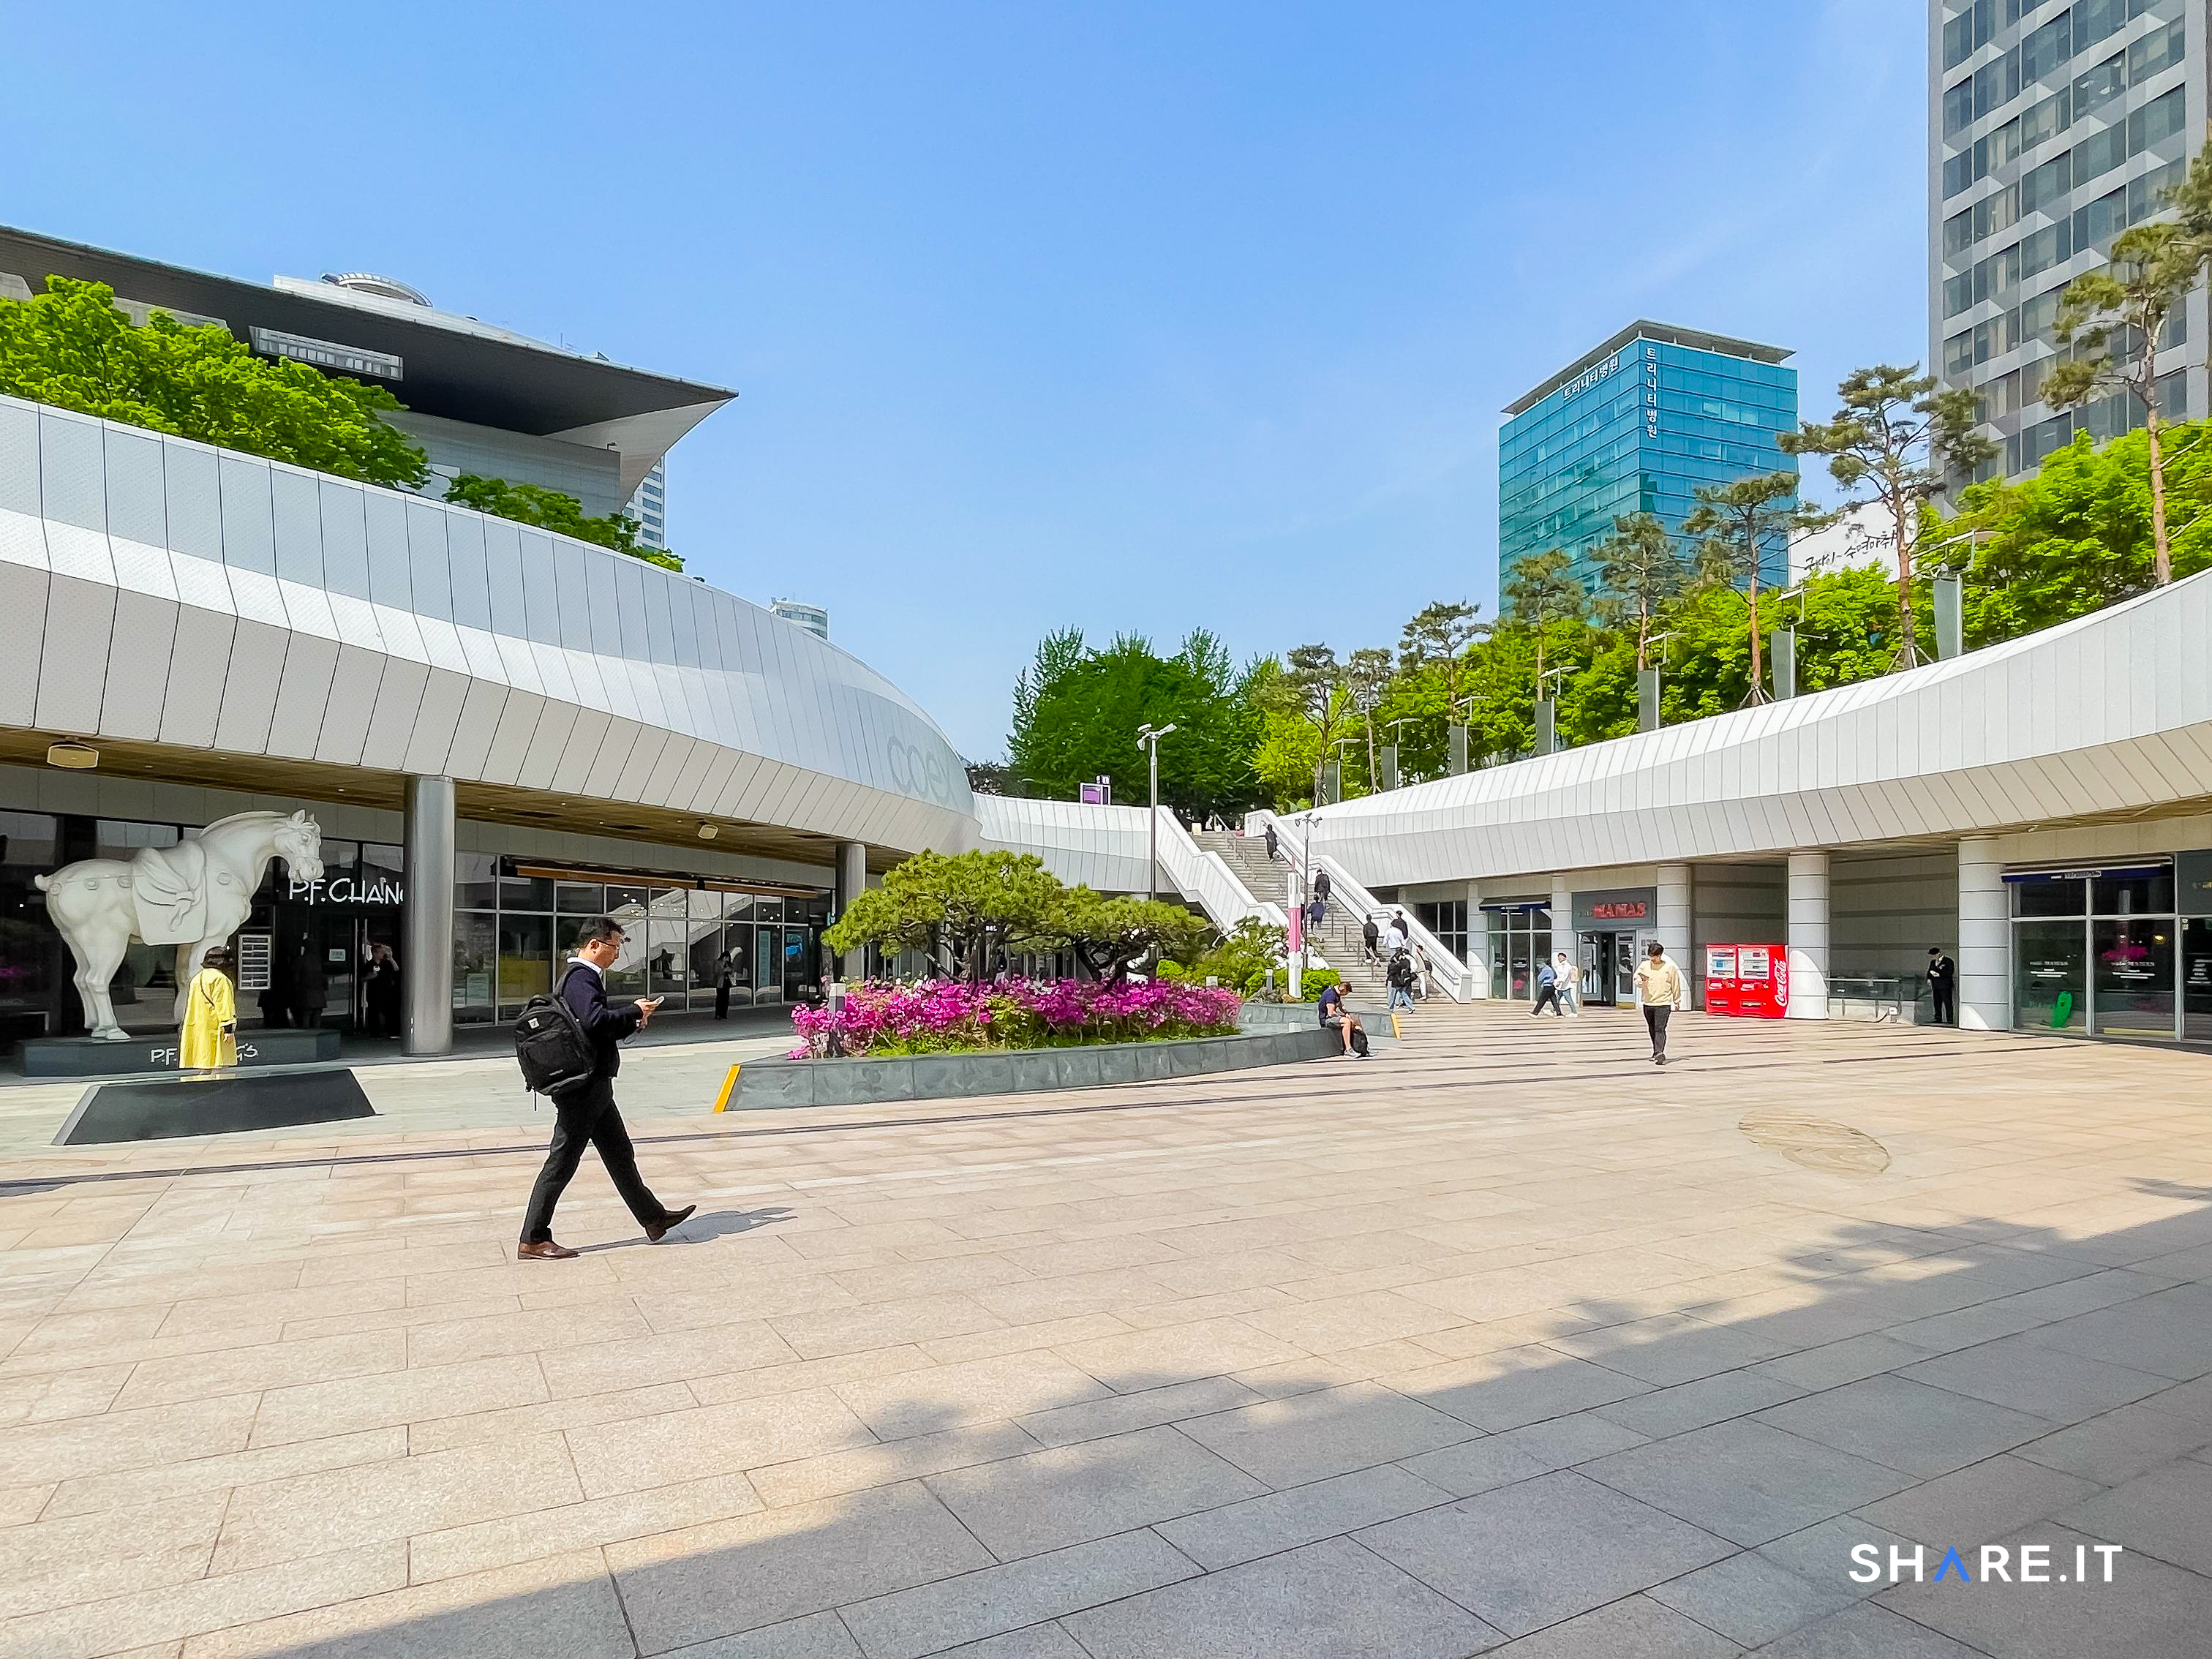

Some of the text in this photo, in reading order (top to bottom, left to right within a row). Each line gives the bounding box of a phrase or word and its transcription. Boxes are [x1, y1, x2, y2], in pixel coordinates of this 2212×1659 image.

[1564, 355, 1619, 401] 트리니티병원
[1646, 347, 1658, 439] 트리니티병원
[1844, 530, 1896, 559] 수면마취
[289, 879, 326, 906] P.F.
[151, 1047, 178, 1066] P.F.
